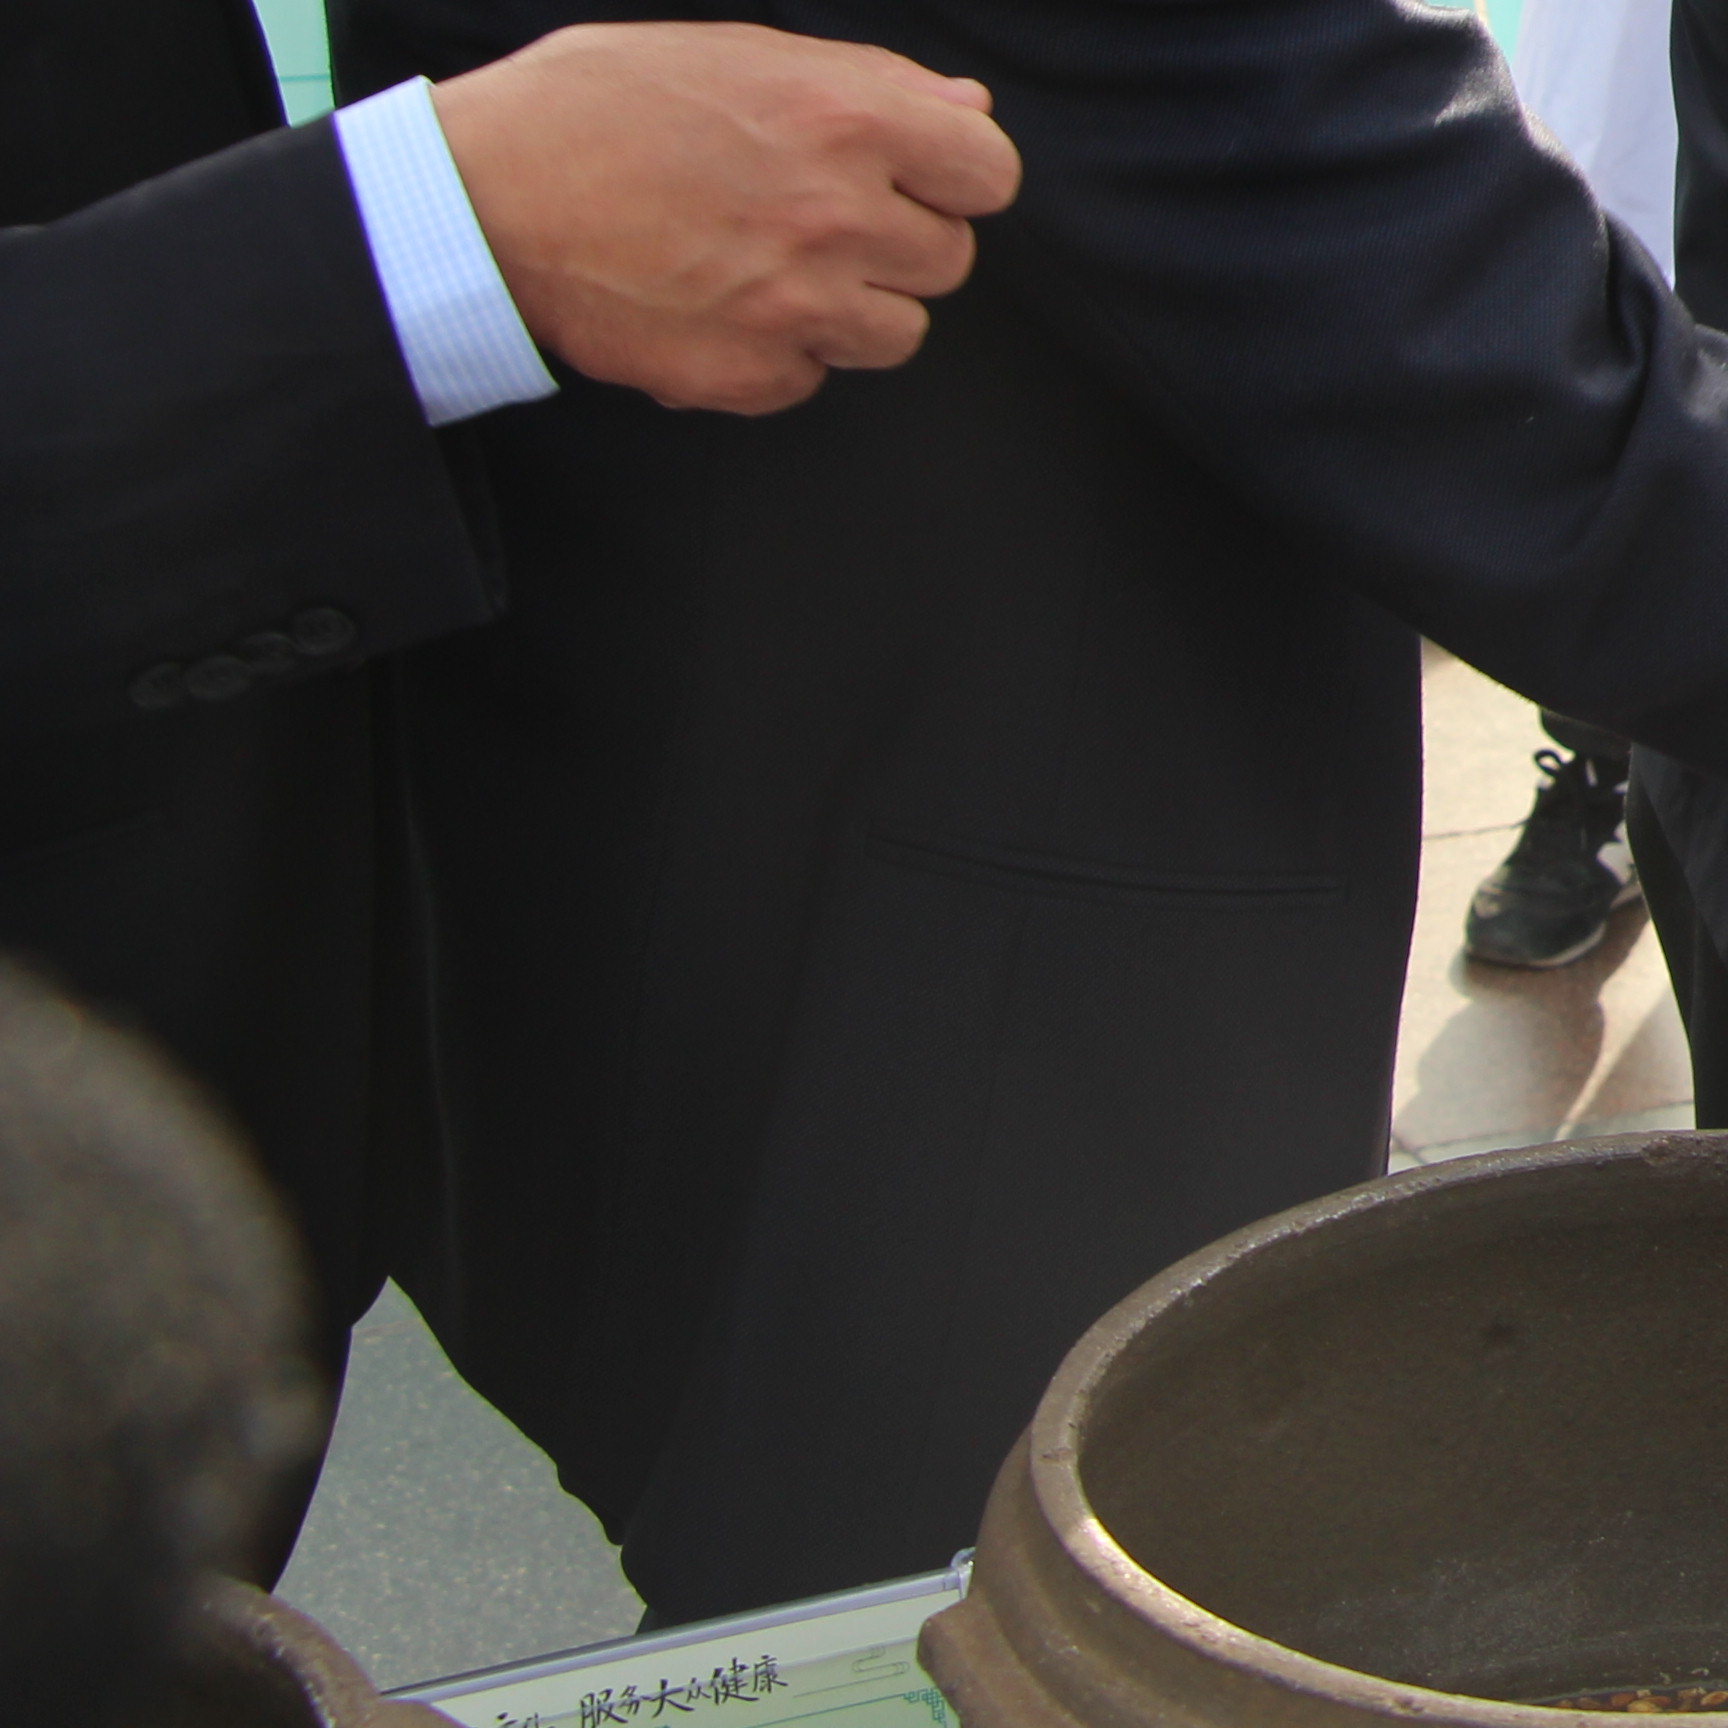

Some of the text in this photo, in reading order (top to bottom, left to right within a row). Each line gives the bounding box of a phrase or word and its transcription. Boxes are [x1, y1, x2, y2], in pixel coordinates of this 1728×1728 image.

[579, 1654, 789, 1728] 服务大众健康
